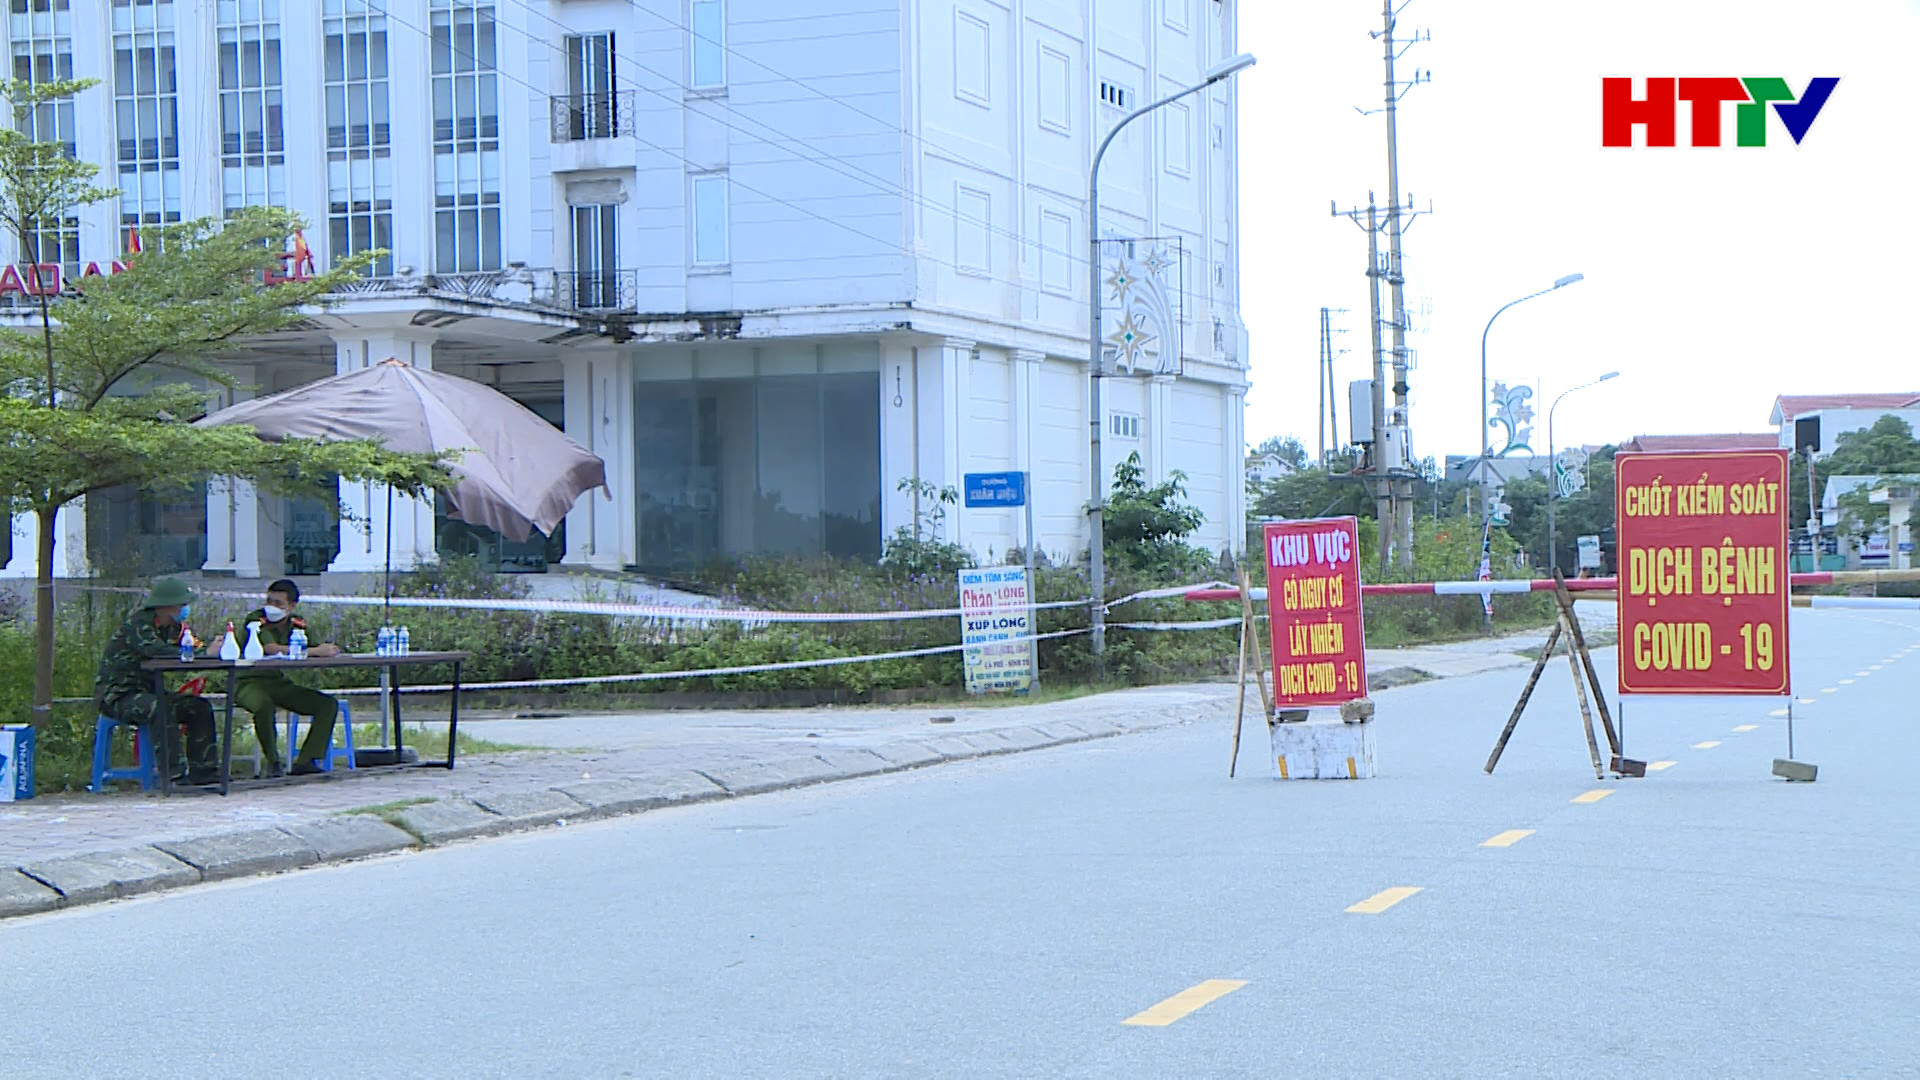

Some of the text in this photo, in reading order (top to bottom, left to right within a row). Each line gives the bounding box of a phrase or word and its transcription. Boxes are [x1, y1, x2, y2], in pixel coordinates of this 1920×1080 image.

[1625, 471, 1779, 517] CHỐT KIỂM SOÁT
[1271, 528, 1351, 570] KHU VỰC
[1630, 536, 1775, 606] DỊCH BỆNH
[1284, 574, 1344, 610] CÓ NGUY CƠ
[1289, 611, 1344, 656] LÂY NHIỄM
[1633, 622, 1774, 671] COVID - 19
[1280, 663, 1305, 702] DỊCH
[1306, 661, 1336, 694] COVID
[1344, 661, 1358, 692] 19
